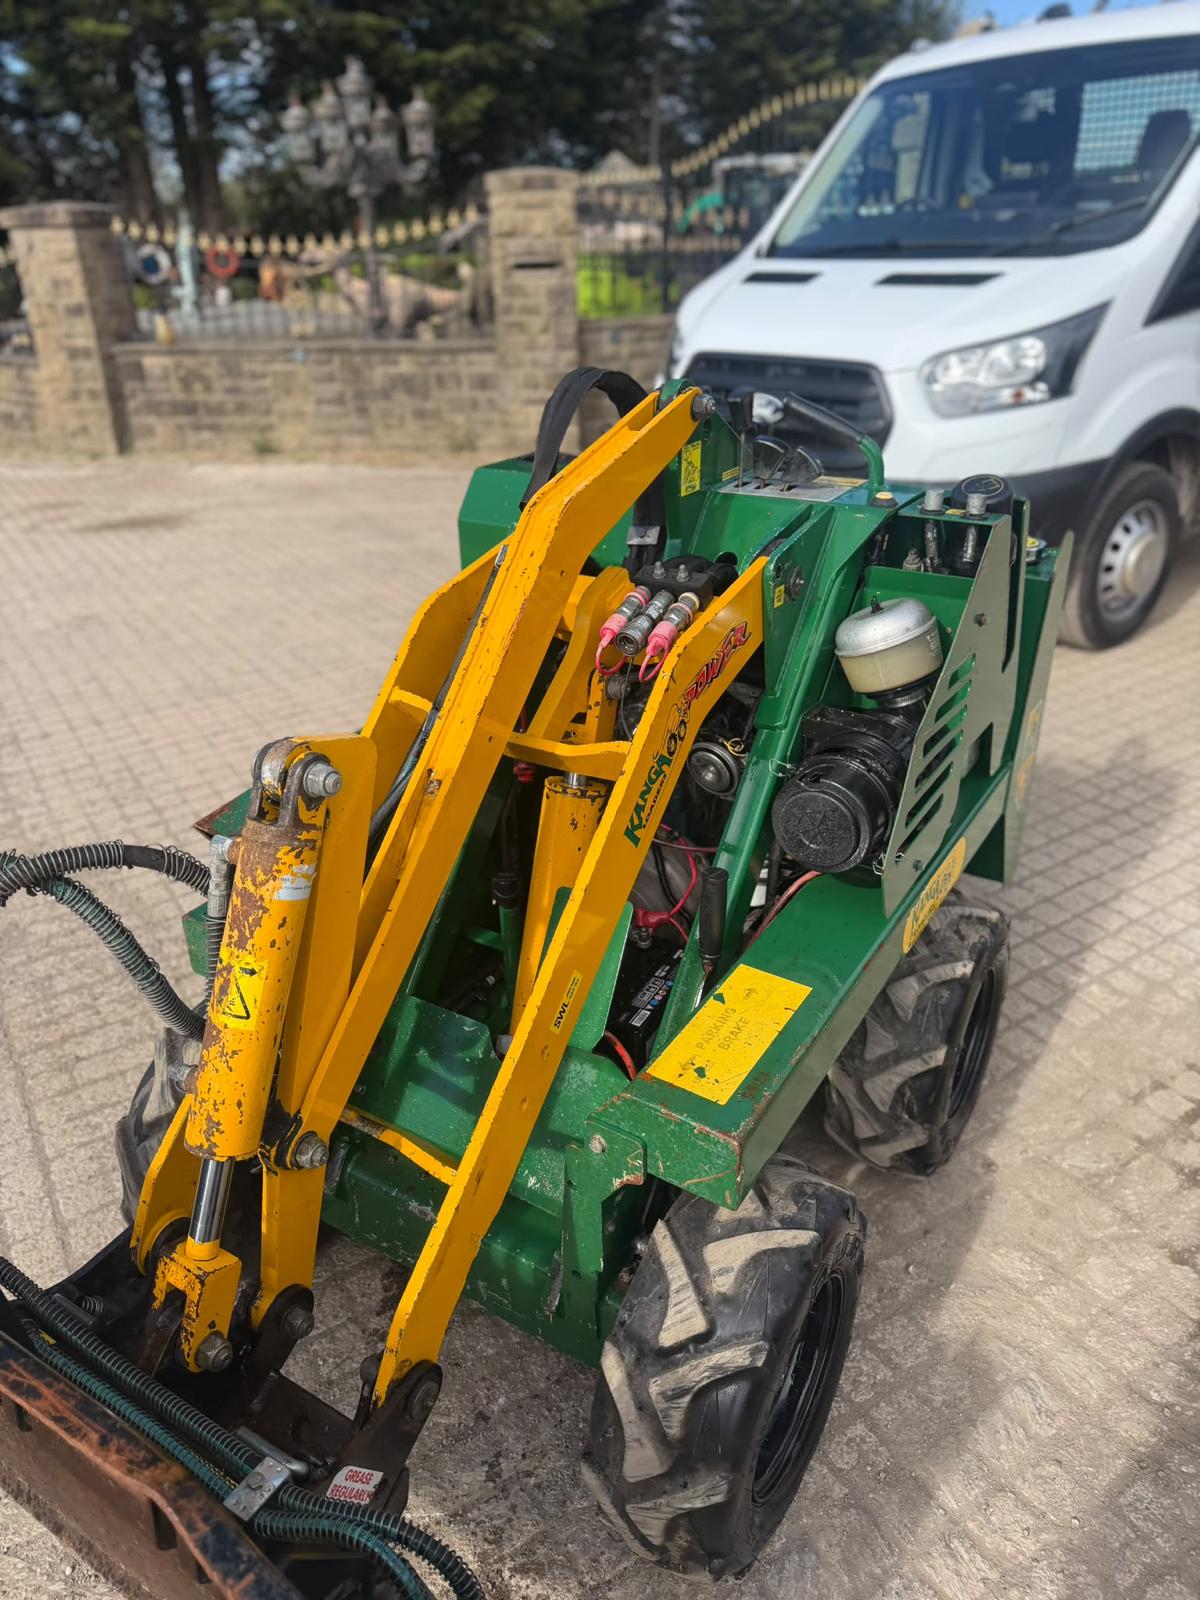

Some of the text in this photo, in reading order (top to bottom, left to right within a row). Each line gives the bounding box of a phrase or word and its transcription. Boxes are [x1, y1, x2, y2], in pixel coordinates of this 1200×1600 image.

[554, 1001, 570, 1029] SWL
[696, 1006, 737, 1050] PARKING
[718, 1016, 750, 1050] BRAKE
[345, 1469, 374, 1485] GREASE
